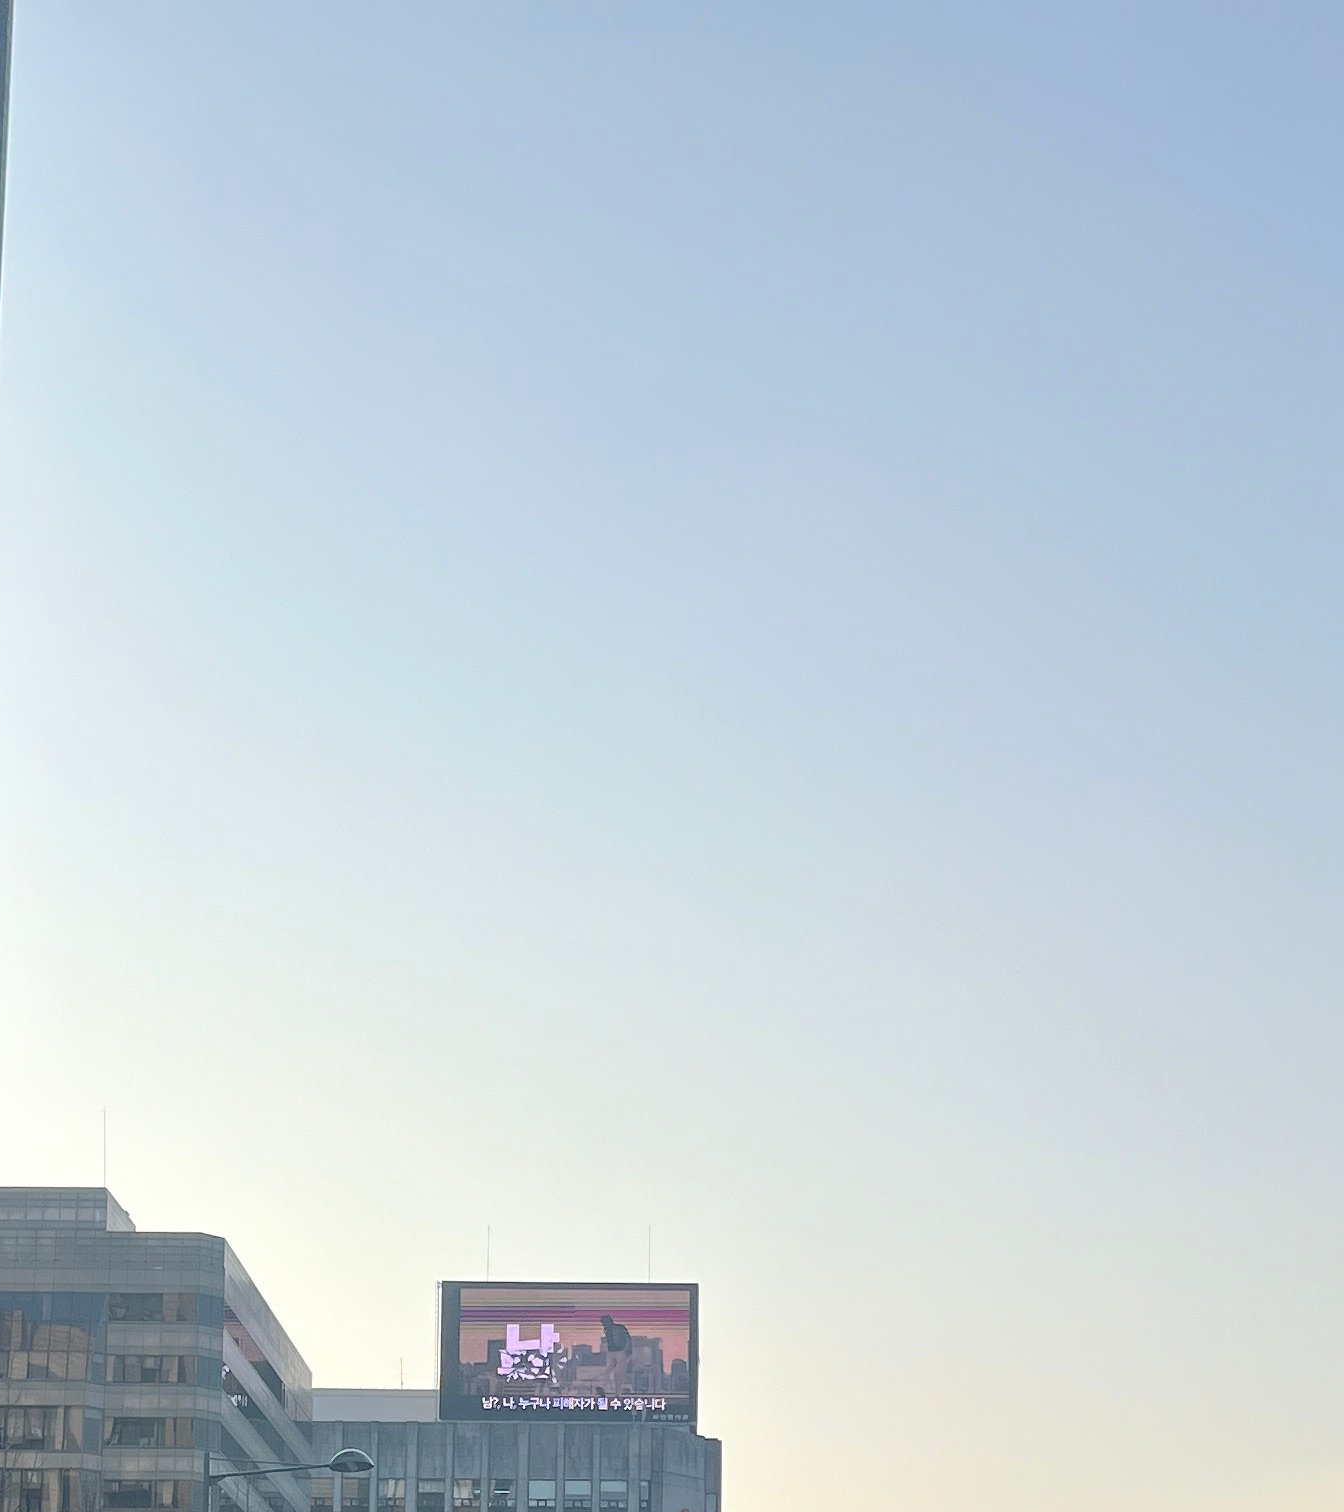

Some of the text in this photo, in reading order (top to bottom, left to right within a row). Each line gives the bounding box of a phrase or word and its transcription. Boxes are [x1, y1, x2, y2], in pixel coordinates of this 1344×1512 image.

[518, 1397, 551, 1411] 누구나
[553, 1397, 596, 1411] 피해자가
[610, 1397, 622, 1411] 수
[623, 1397, 666, 1411] 있습니다
